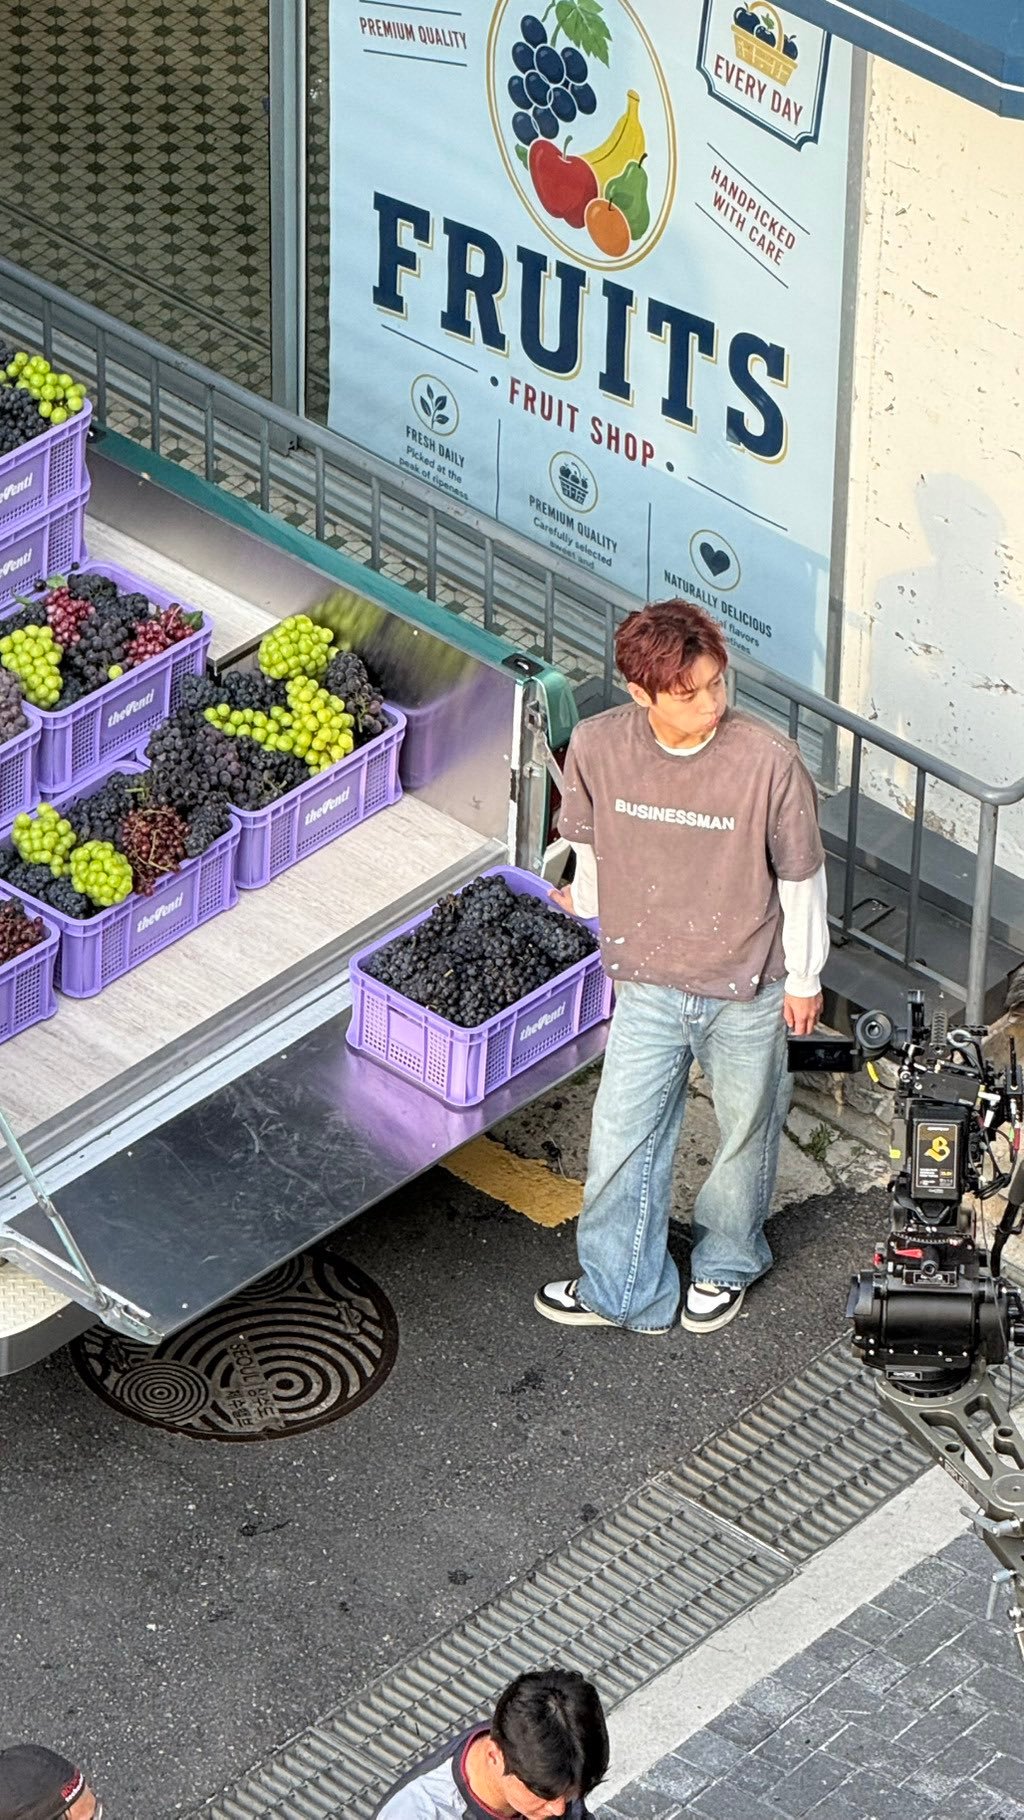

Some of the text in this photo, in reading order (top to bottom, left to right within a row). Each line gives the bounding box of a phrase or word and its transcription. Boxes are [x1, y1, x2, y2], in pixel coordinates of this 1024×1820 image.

[359, 16, 467, 50] PREMIUM QUALITY
[714, 54, 803, 126] EVERY DAY
[711, 165, 796, 250] HANDPICKED
[713, 191, 784, 266] WITH CARE
[372, 190, 789, 464] FRUITS
[509, 376, 656, 468] FRUIT SHOP
[406, 425, 465, 468] FRESH DAILY
[406, 445, 462, 484] Picked at the
[0, 472, 33, 504] eVenti
[399, 457, 469, 501] peak of ripeness
[528, 494, 618, 554] PREMIUM QUALITY
[533, 516, 613, 567] Carefully selected
[664, 569, 718, 609] NATURALLY
[721, 601, 773, 639] DELICIOUS
[729, 623, 760, 648] flavors
[108, 688, 154, 728] theVenti
[304, 786, 350, 826] theVenti
[615, 798, 735, 831] BUSINESSMAN
[137, 891, 184, 933] theVenti
[520, 1001, 566, 1041] theVenti
[229, 1343, 260, 1383] SEOUL
